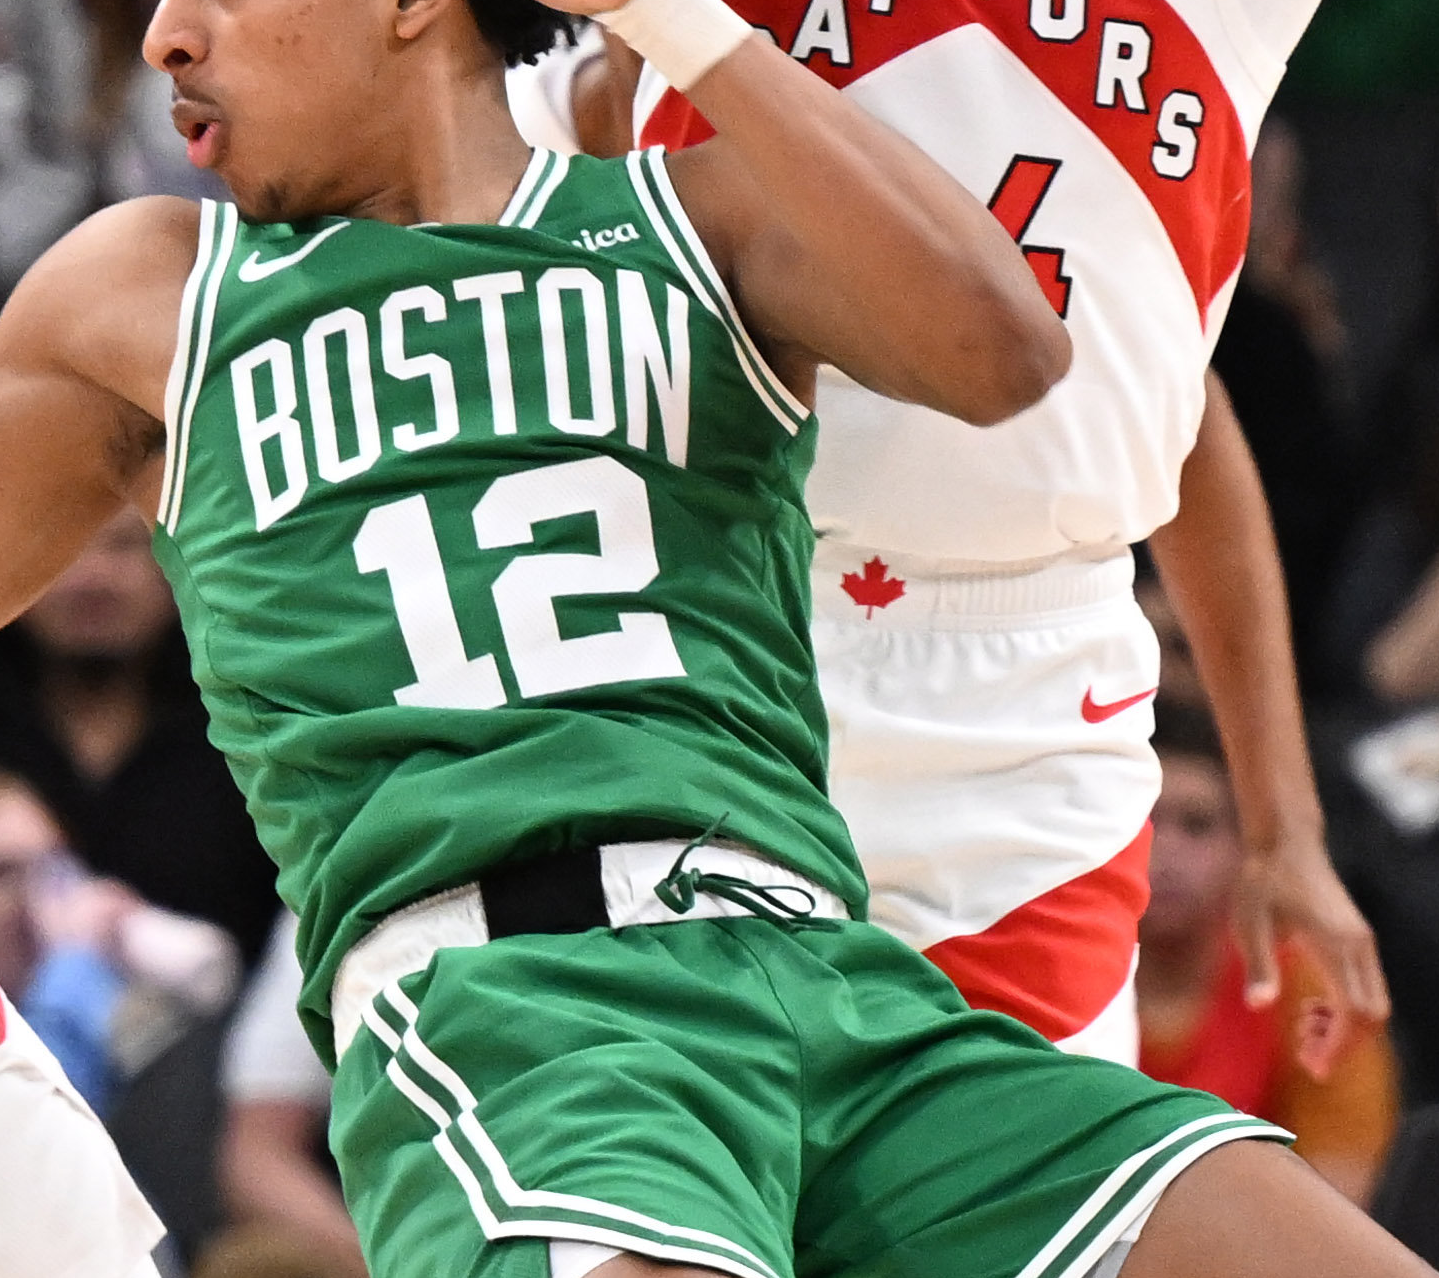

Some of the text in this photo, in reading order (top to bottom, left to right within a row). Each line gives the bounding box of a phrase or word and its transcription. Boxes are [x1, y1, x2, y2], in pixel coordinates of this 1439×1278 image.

[570, 222, 641, 253] ica
[230, 267, 690, 533] BOSTON
[352, 455, 689, 710] 12
